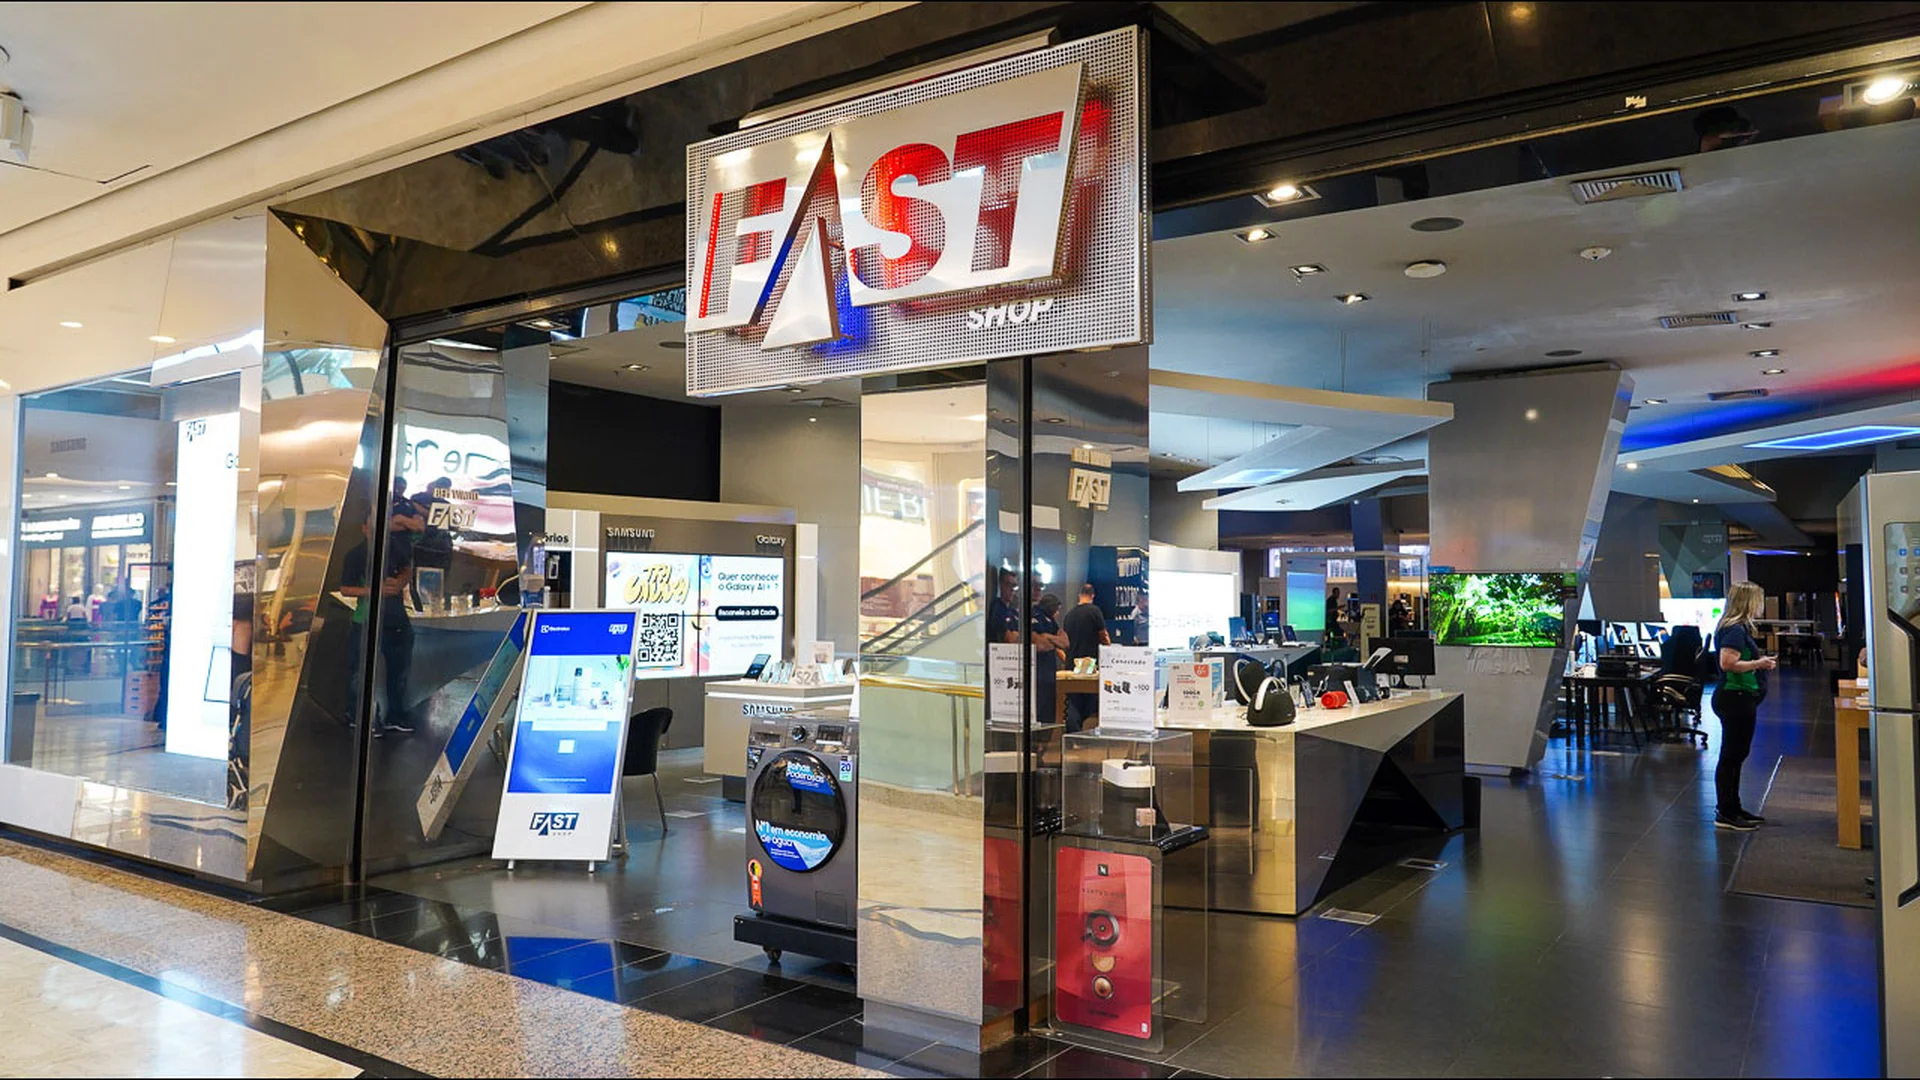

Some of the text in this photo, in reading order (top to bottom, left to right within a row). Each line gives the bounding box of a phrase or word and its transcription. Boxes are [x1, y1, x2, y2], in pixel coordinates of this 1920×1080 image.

[698, 110, 1065, 351] FAST
[967, 298, 1053, 332] SHOP
[607, 527, 655, 538] SAMSUNG
[756, 534, 786, 547] Galaxy
[718, 572, 778, 581] Quer conhecer
[726, 582, 755, 594] Galaxy
[796, 671, 819, 685] S24
[841, 763, 851, 772] 20
[529, 813, 579, 835] FAST
[785, 830, 827, 842] economia
